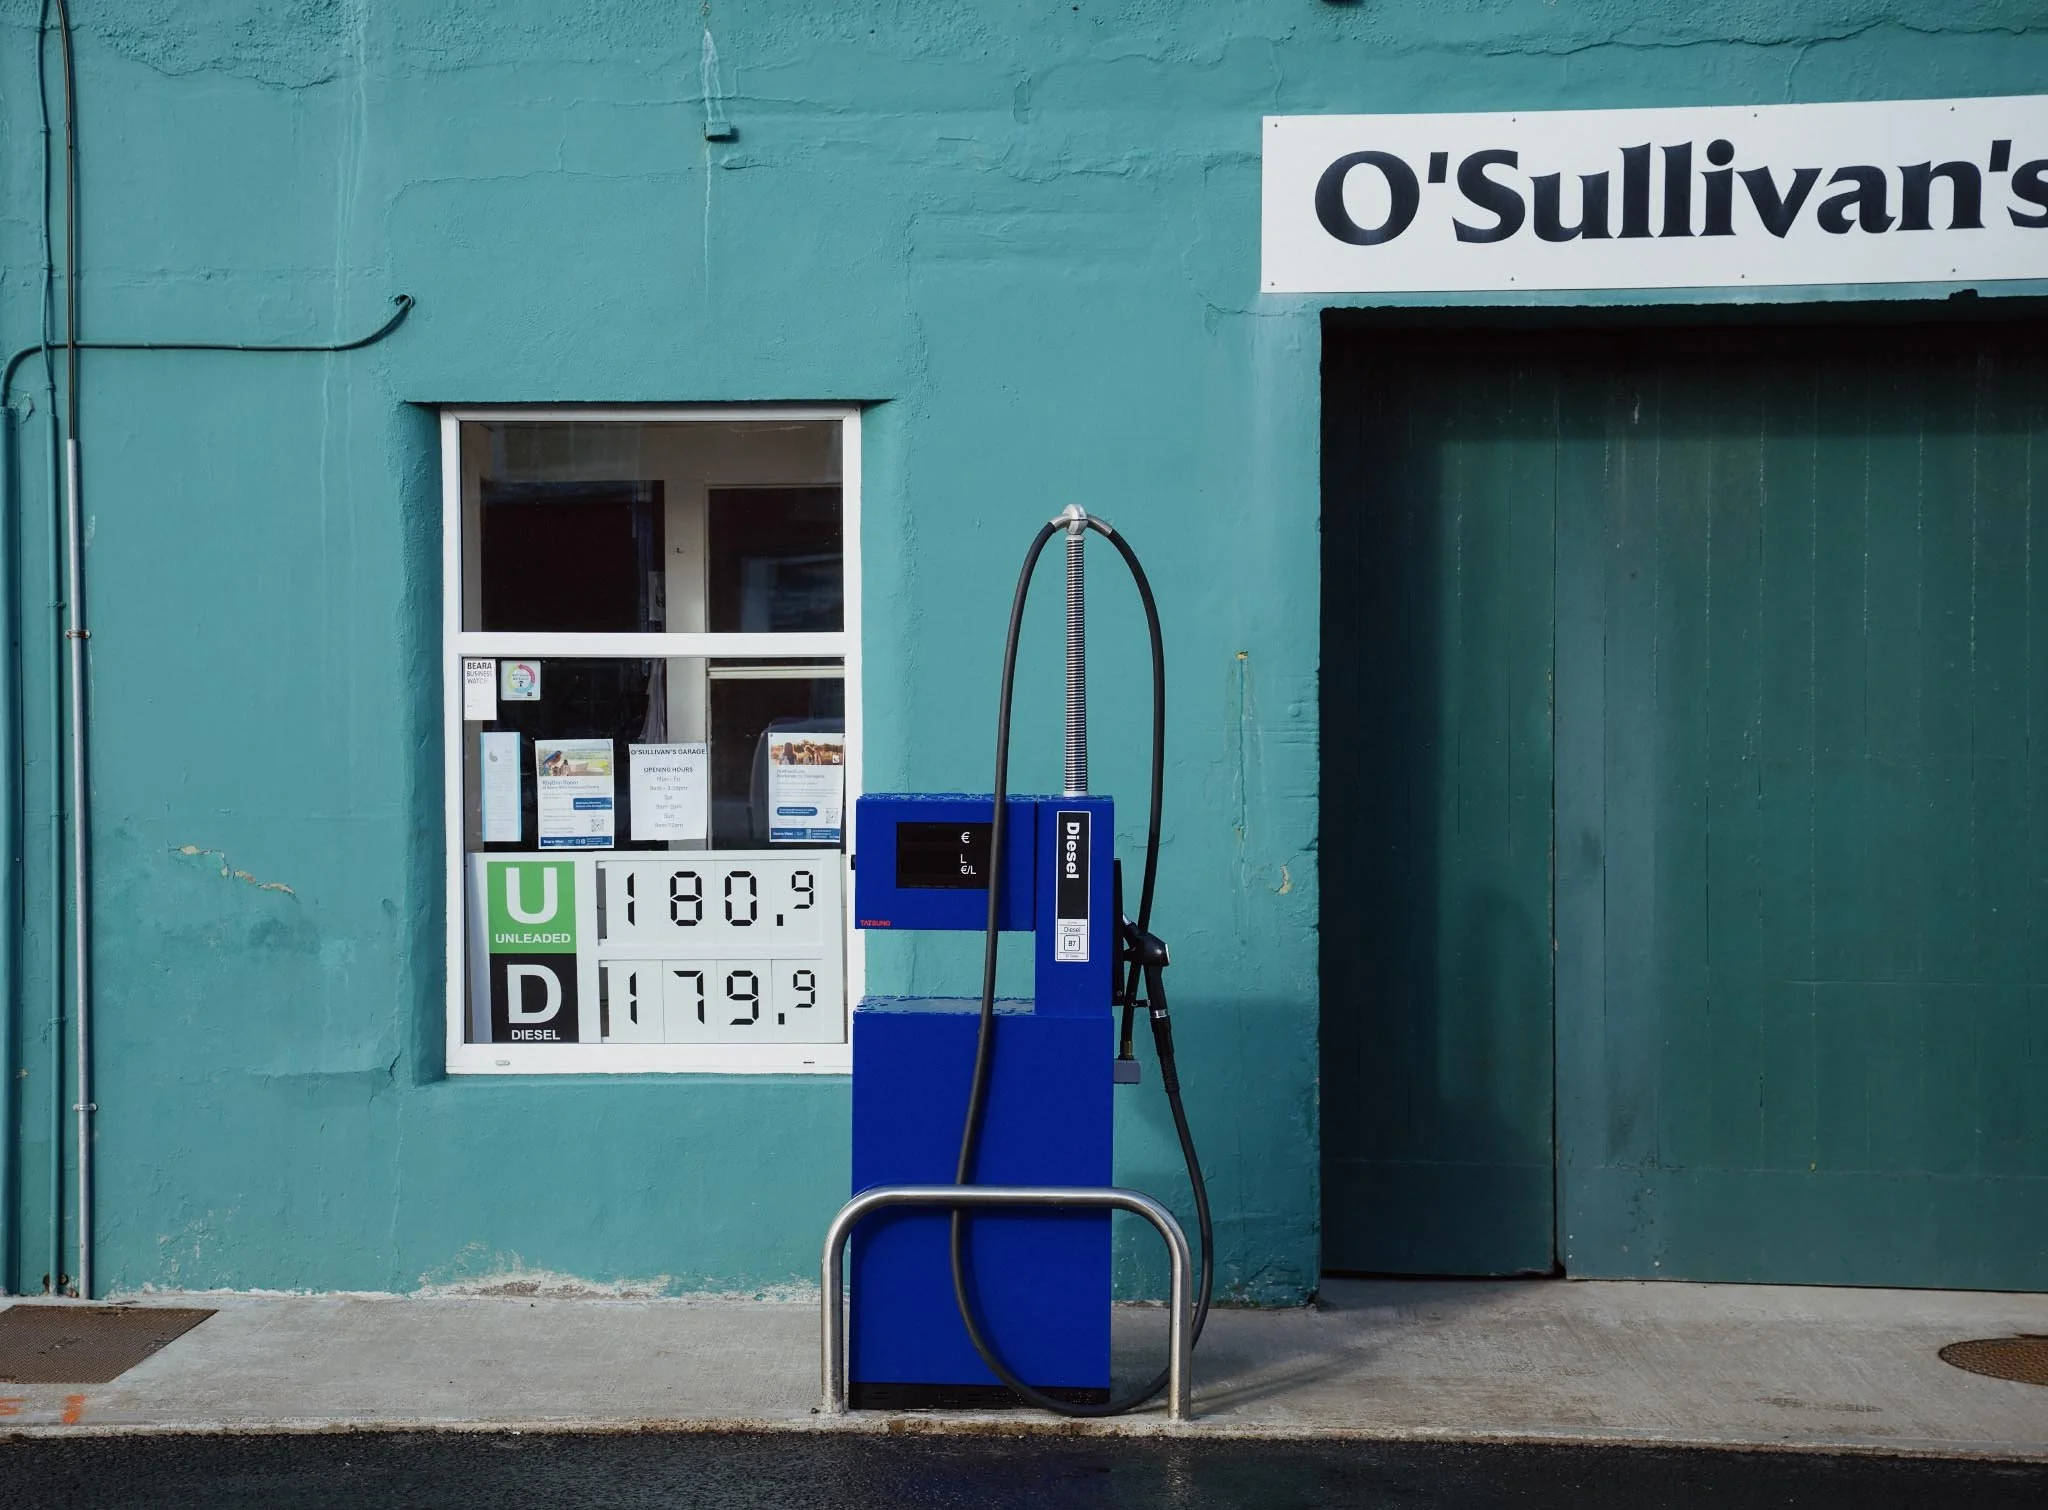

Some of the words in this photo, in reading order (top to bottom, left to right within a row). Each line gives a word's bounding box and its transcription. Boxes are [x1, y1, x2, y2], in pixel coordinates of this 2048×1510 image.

[1315, 139, 2048, 246] O'Sullivan's
[467, 662, 492, 670] BEARA
[960, 831, 970, 844] €
[1065, 821, 1080, 879] Diesel
[960, 853, 967, 864] L
[960, 865, 977, 875] €/L
[506, 867, 558, 925] U
[627, 870, 814, 927] 180.9
[495, 933, 571, 943] UNLEADED
[506, 964, 562, 1024] D
[629, 969, 815, 1026] 179.9
[511, 1029, 561, 1041] DIESEL
